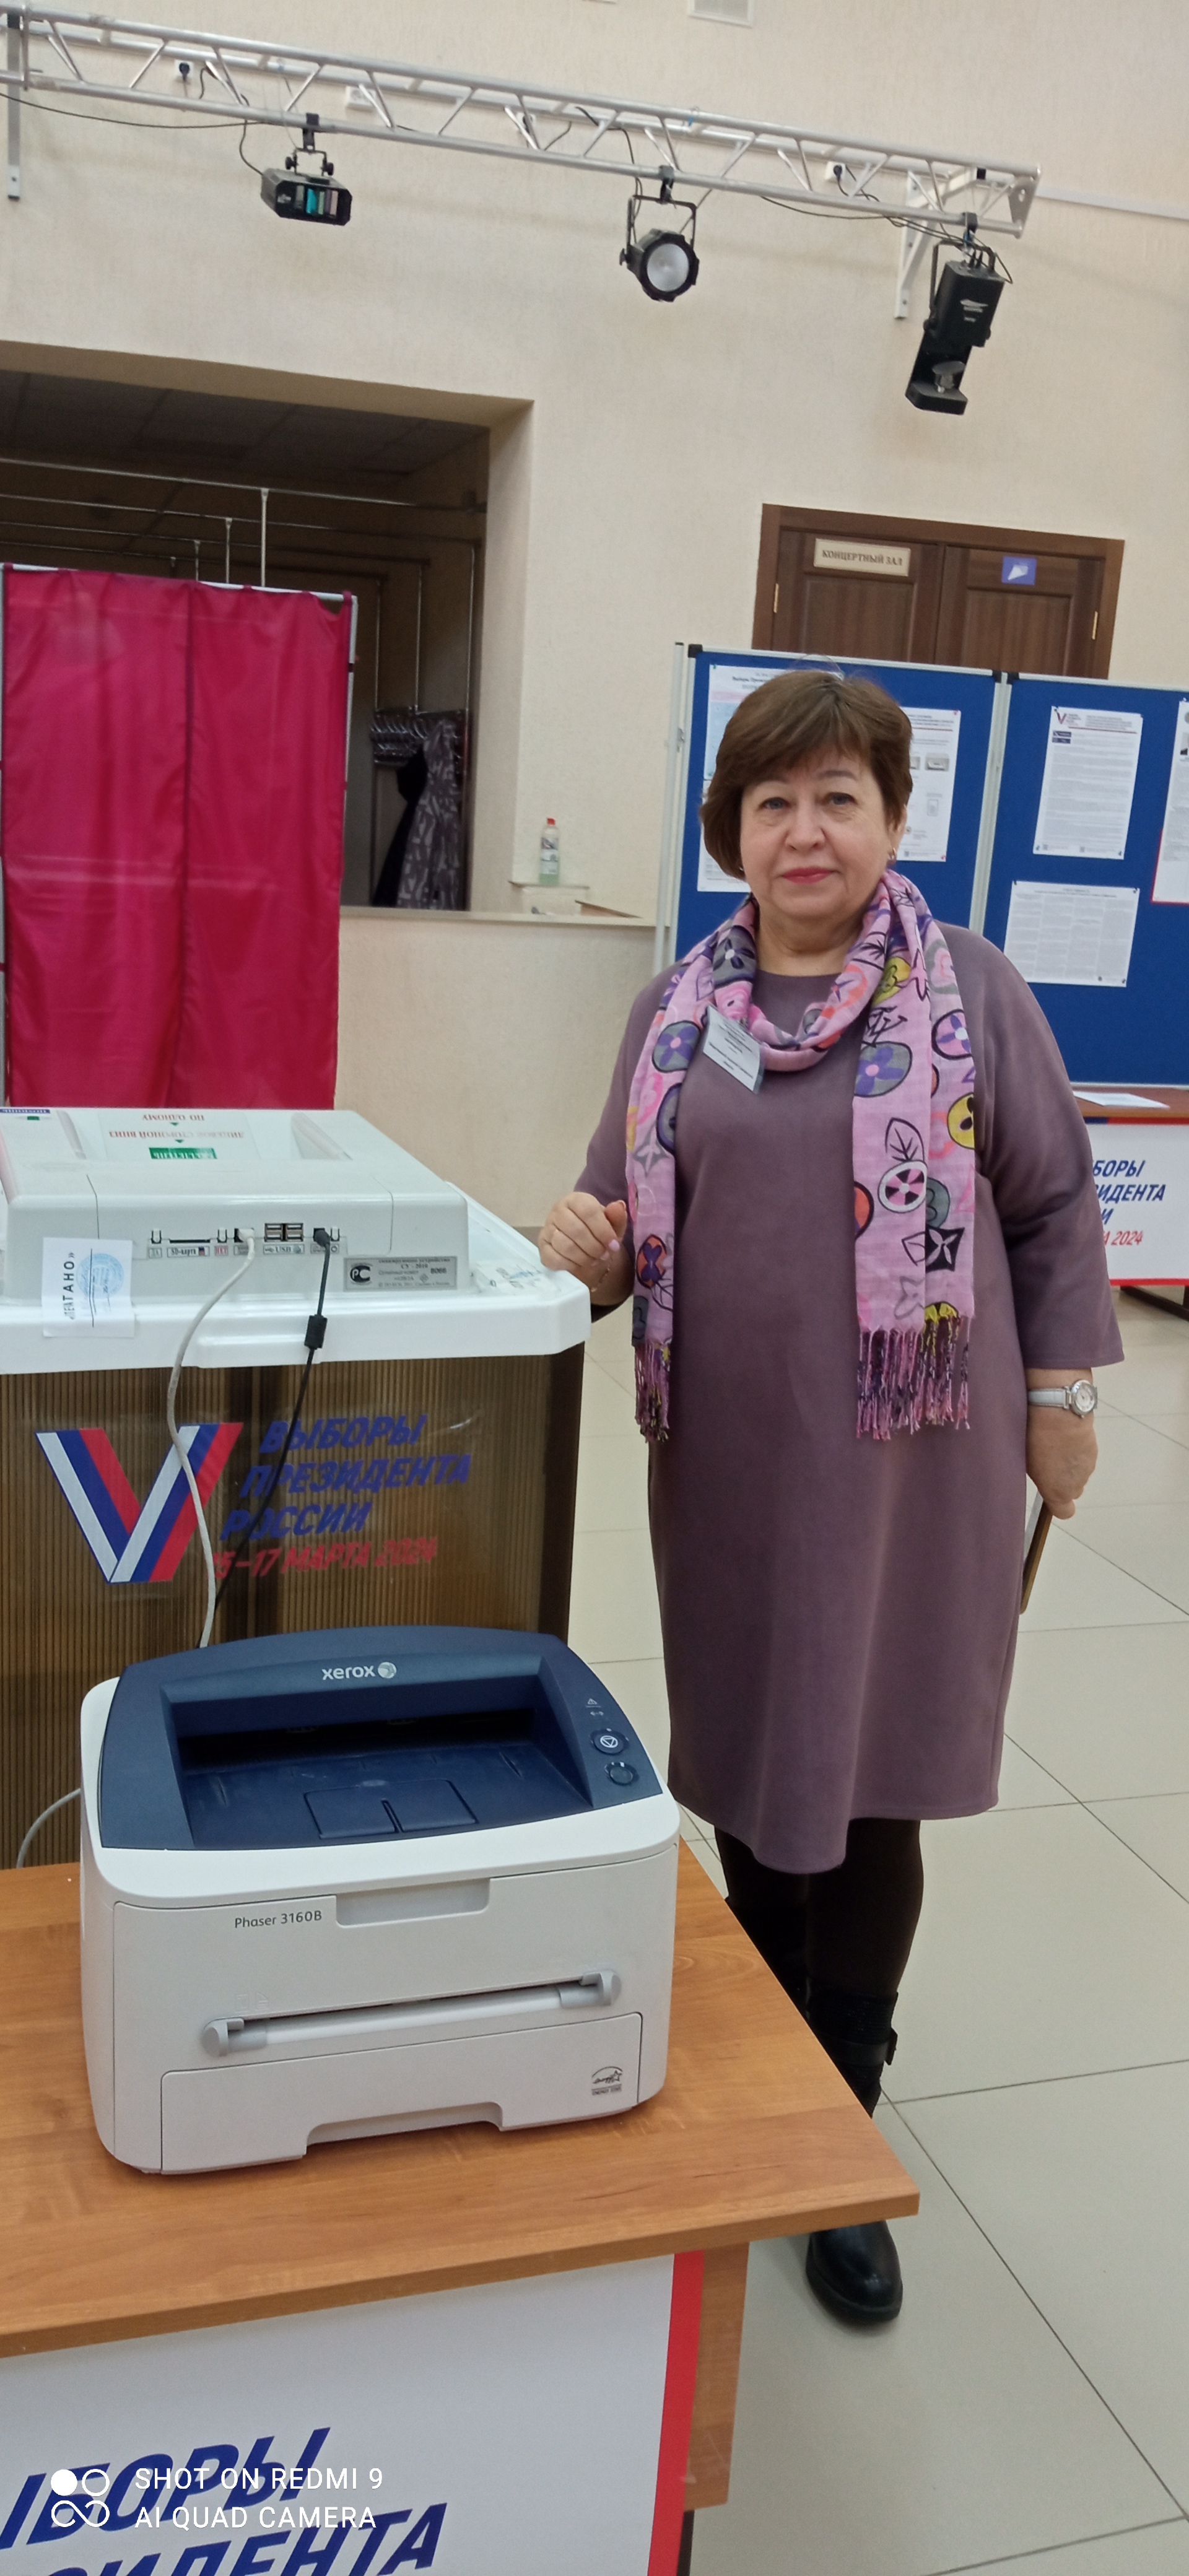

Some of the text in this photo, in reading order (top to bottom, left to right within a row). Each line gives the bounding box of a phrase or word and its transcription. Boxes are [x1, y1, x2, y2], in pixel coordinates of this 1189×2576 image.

[822, 549, 903, 566] КОНЦЕРТНЫЙ ЗАЛ
[108, 1130, 136, 1138] ВНИЗ
[1093, 1159, 1146, 1177] БОРЫ
[1110, 1230, 1144, 1246] 2024
[259, 1414, 428, 1454] ВЫБОРЫ
[239, 1453, 472, 1498] ПРЕЗИДЕНТА
[220, 1501, 372, 1541] РОССИИ
[281, 1541, 372, 1574] МАРТА
[373, 1536, 437, 1568] 2024
[321, 1665, 377, 1681] xerox
[234, 1910, 322, 1928] Phaser 3160B
